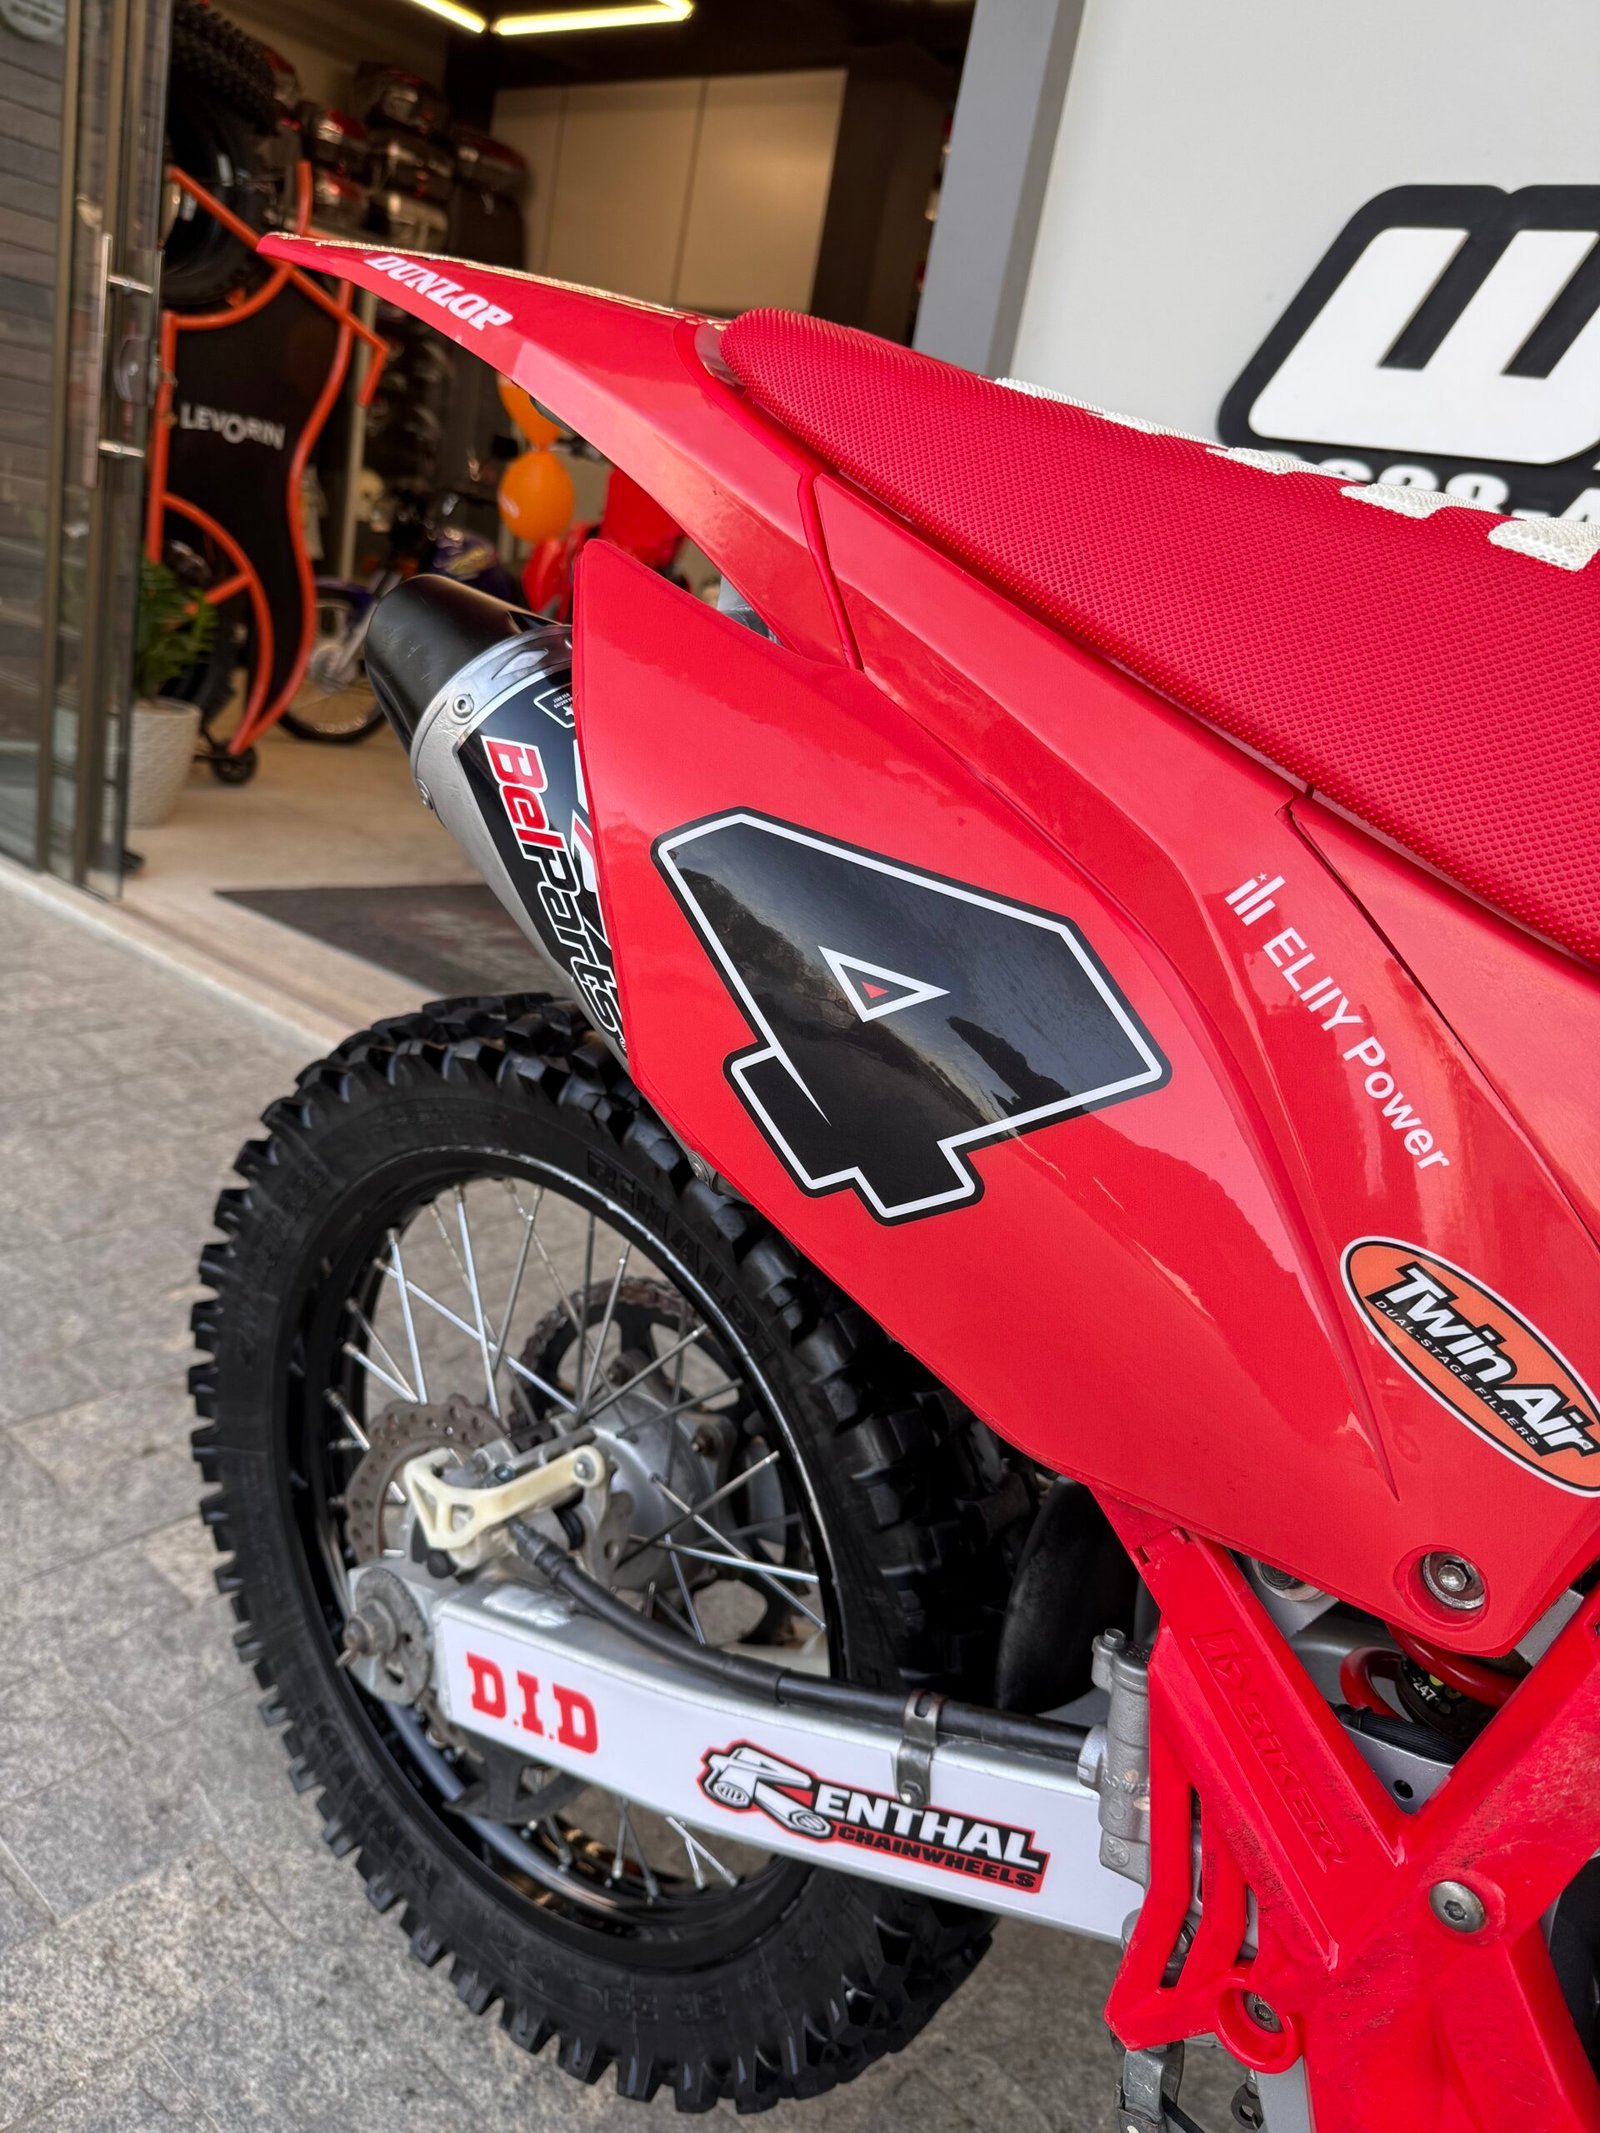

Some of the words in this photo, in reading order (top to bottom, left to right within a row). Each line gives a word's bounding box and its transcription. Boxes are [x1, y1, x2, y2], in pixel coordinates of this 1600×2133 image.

[363, 255, 513, 332] DUNLOP
[180, 402, 286, 451] LEVORIN
[651, 806, 1172, 1226] 4
[1342, 1035, 1450, 1170] Power
[1474, 1386, 1539, 1446] FILTERS
[466, 1651, 599, 1754] D.I.D
[837, 1824, 1037, 1889] CHAINWHEELS
